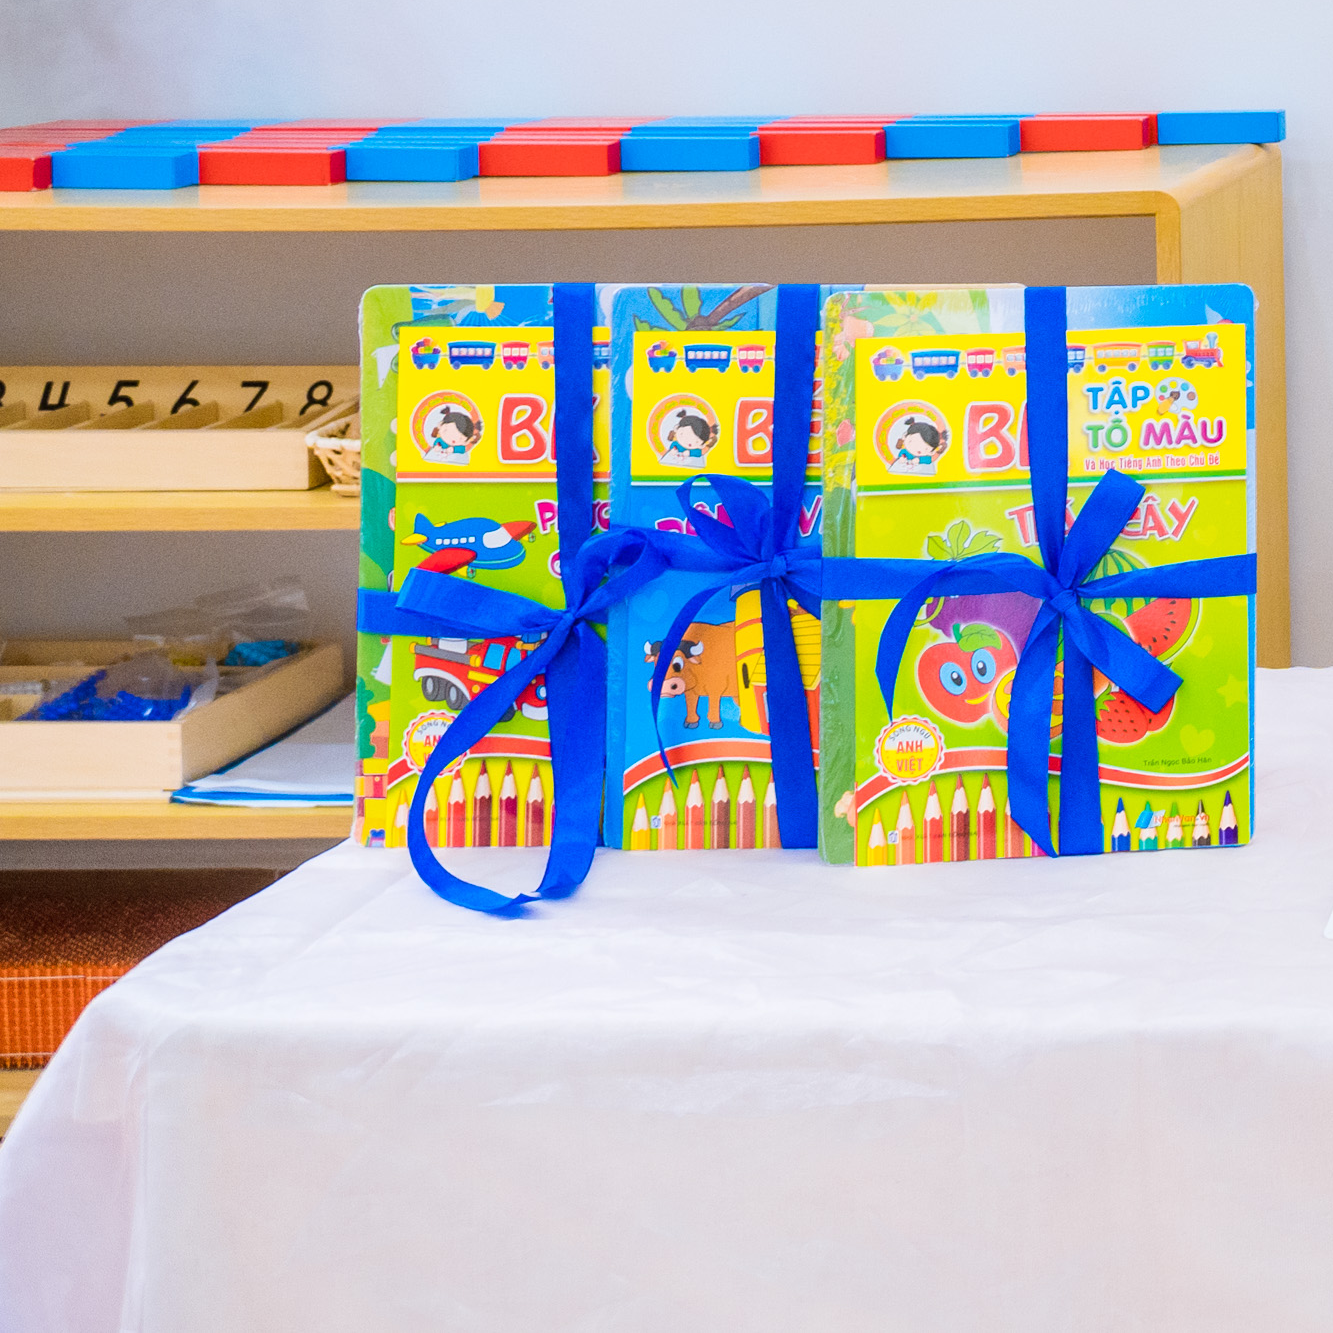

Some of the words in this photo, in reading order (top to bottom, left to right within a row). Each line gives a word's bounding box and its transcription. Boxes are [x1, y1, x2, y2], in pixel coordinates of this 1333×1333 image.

[1085, 380, 1151, 415] TẬP
[1085, 417, 1129, 449] TÔ
[1142, 414, 1224, 447] MÀU
[1146, 456, 1162, 468] Anh
[1165, 455, 1186, 467] Theo
[424, 735, 441, 747] AN
[889, 724, 912, 741] SONG
[896, 740, 923, 754] ANH
[896, 755, 924, 774] VIỆT
